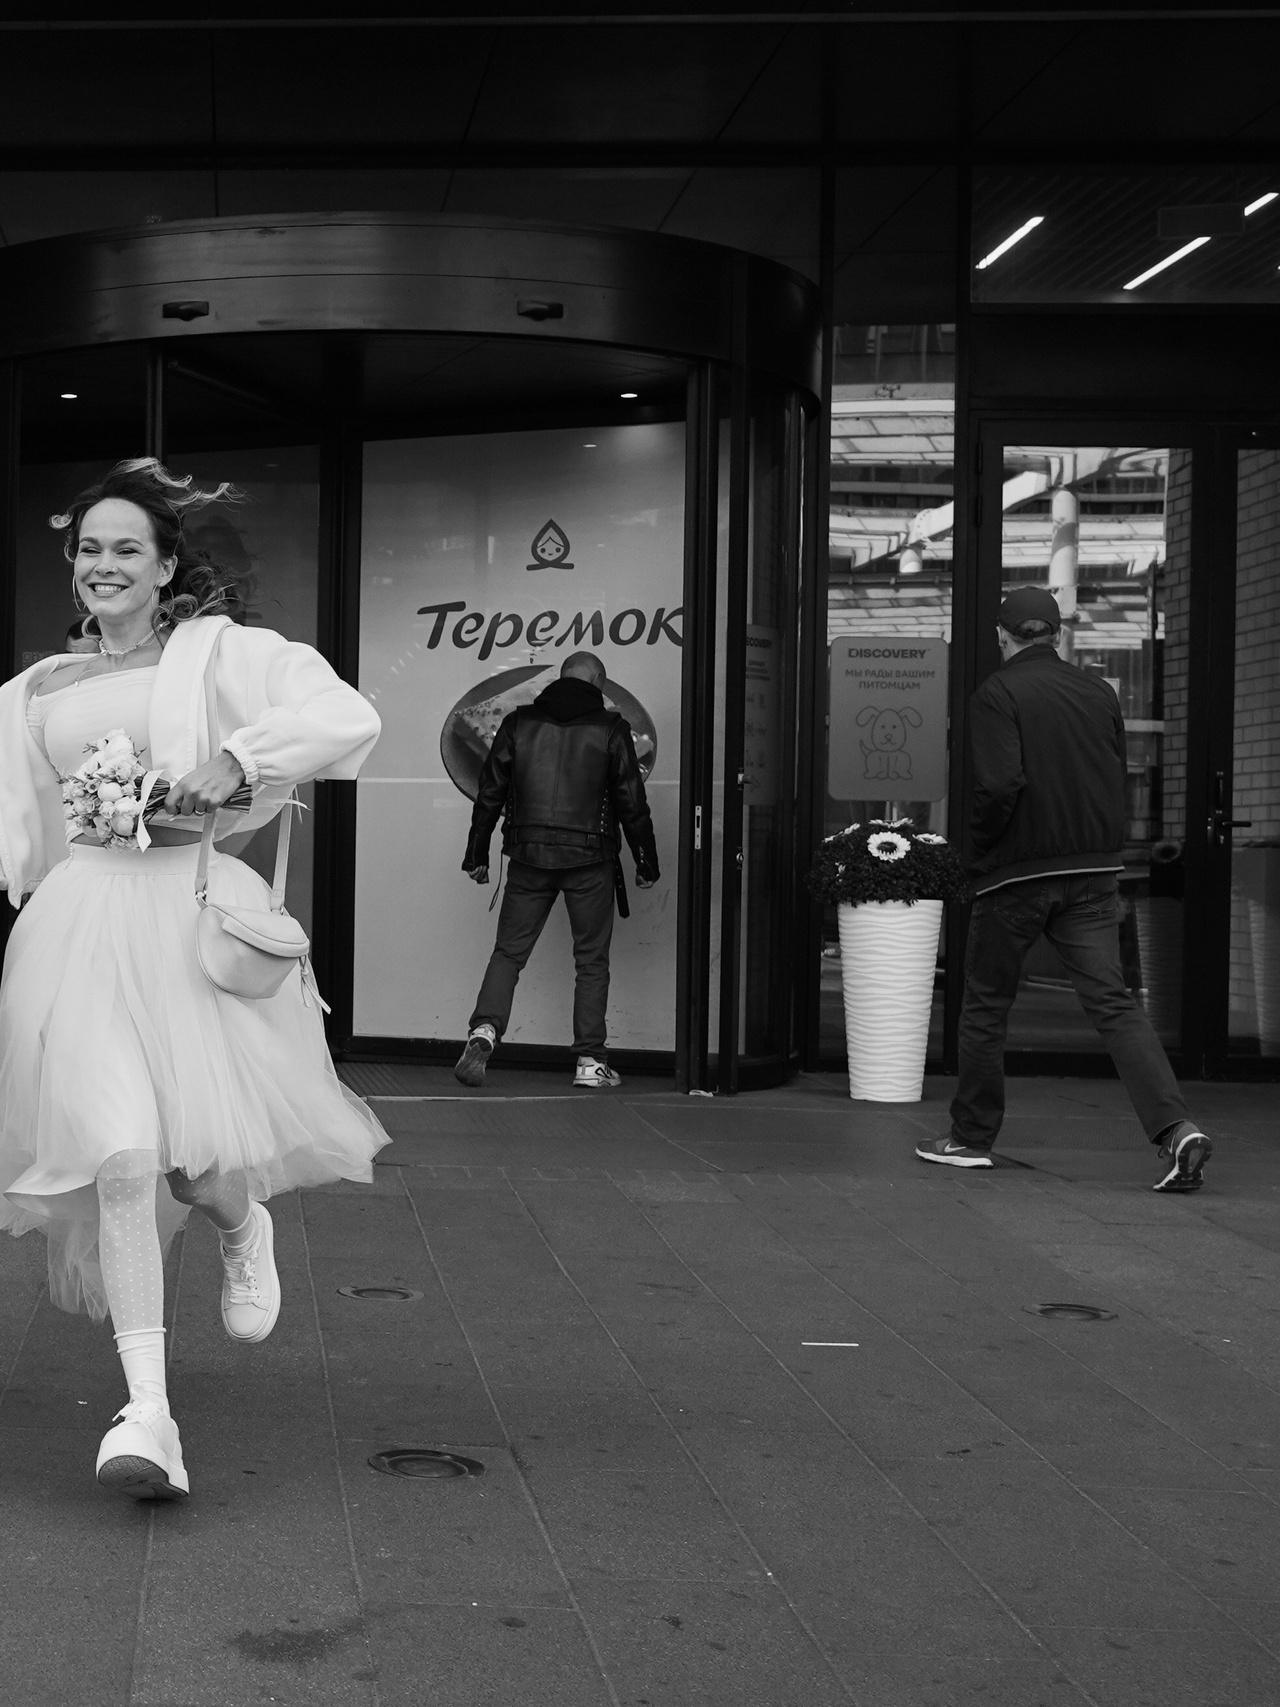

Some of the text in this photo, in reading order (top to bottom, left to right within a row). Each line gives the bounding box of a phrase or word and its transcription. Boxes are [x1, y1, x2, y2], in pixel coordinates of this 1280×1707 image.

[417, 601, 683, 661] Теремок
[745, 637, 772, 649] SCOVERY
[848, 648, 927, 659] DISCOVERY
[845, 669, 935, 679] МЫ РАДЫ ВАШИМ
[859, 681, 920, 690] ПИТОМЦАМ
